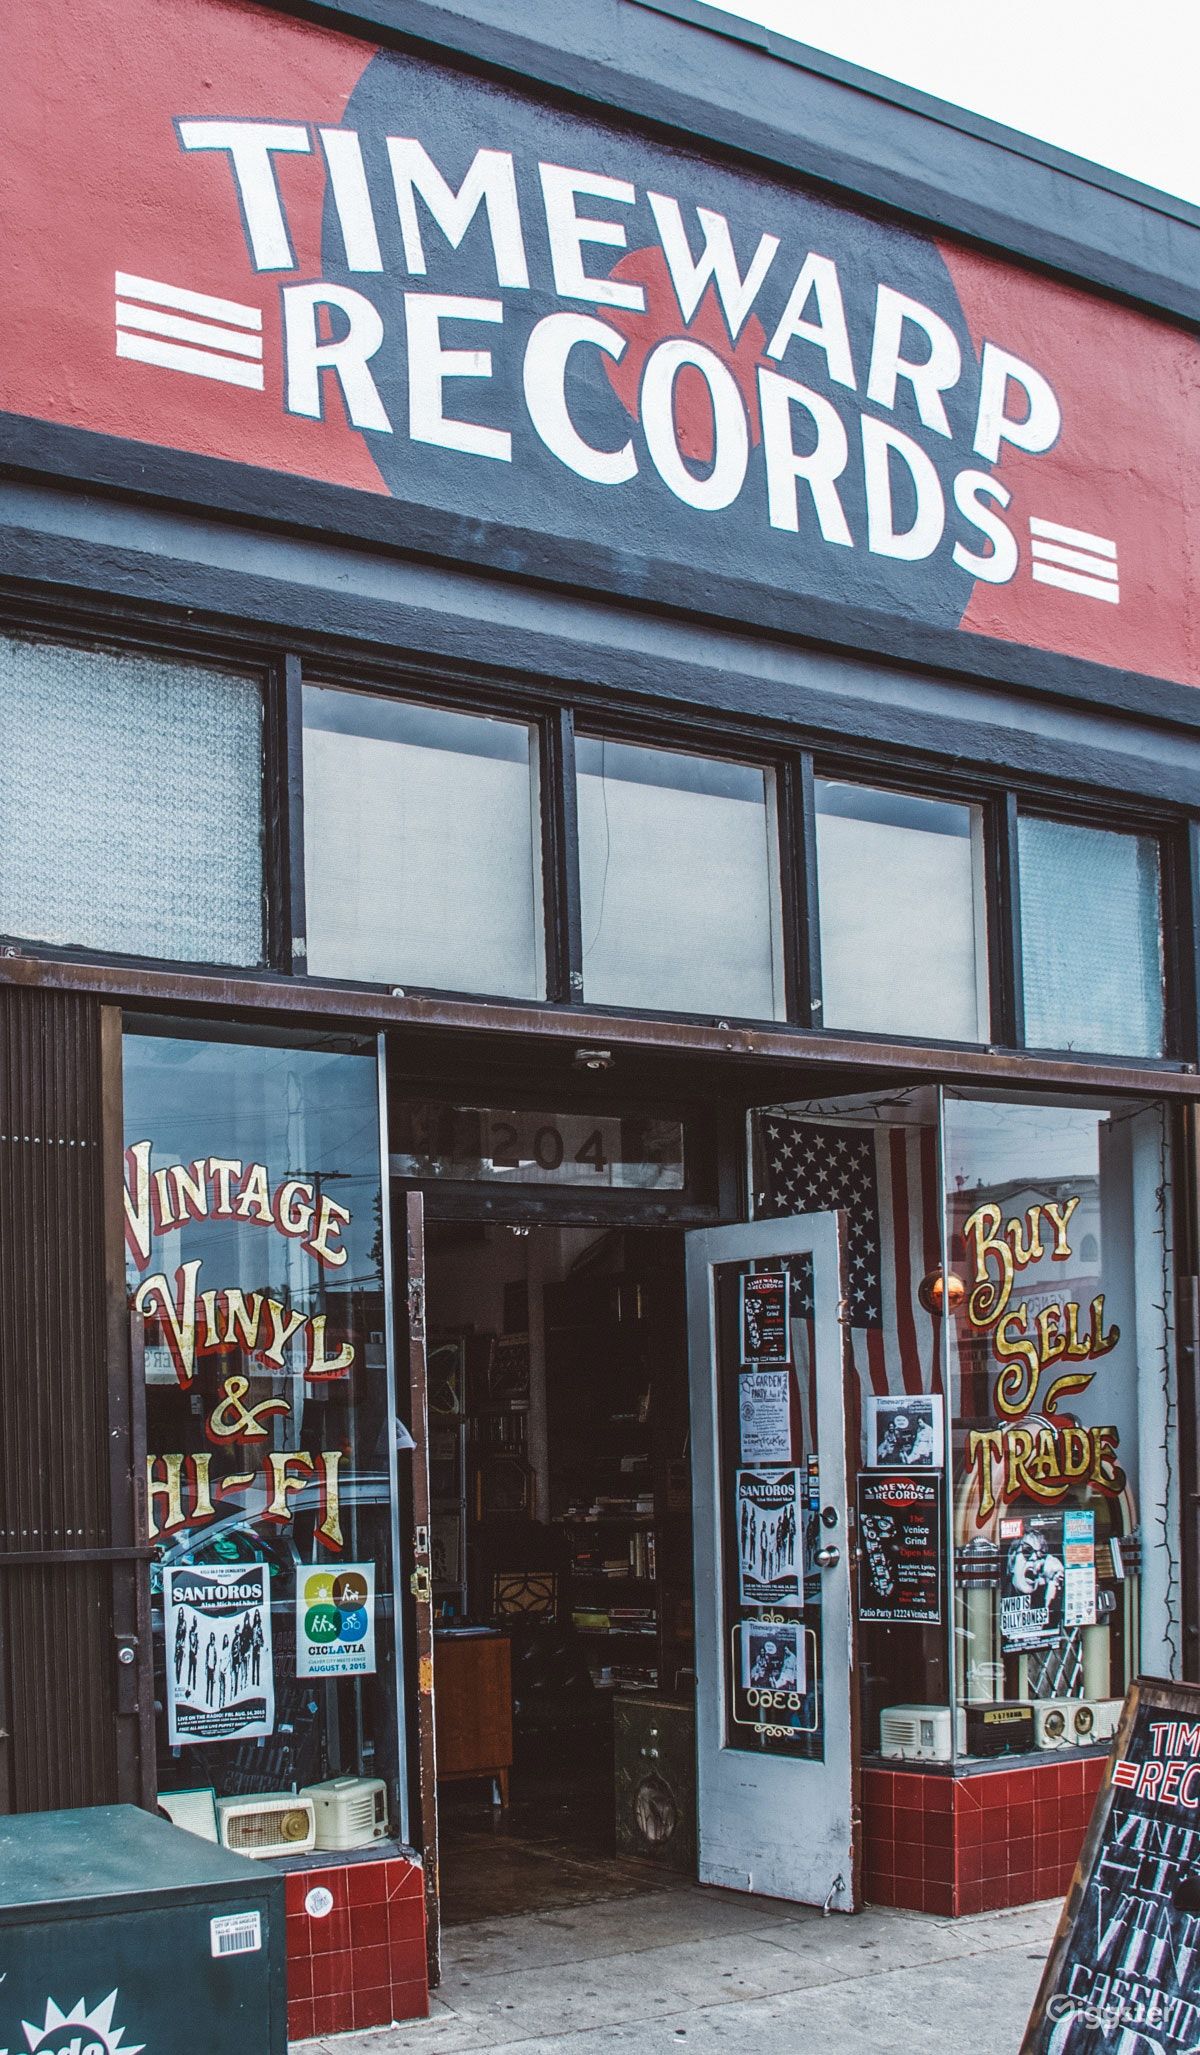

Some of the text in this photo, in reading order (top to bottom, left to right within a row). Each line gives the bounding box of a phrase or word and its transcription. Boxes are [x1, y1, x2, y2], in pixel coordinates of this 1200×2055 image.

[178, 121, 1061, 463] TIMEWARP
[282, 283, 1018, 584] RECORDS
[491, 1122, 607, 1173] 204
[124, 1139, 350, 1267] VINTAGE
[964, 1196, 1081, 1327] BUY
[135, 1259, 355, 1382] VINYL
[995, 1294, 1121, 1415] SELL
[211, 1375, 291, 1437] &
[740, 1484, 795, 1497] SANTOROS
[864, 1483, 935, 1495] TIMEWARP
[875, 1490, 924, 1500] RECORDS
[969, 1425, 1127, 1518] TRADE
[147, 1451, 343, 1548] HI-FI
[903, 1526, 930, 1534] Venice
[905, 1536, 927, 1545] Grind
[173, 1583, 262, 1602] SANTOROS
[860, 1608, 876, 1617] Patio
[876, 1608, 892, 1618] Party
[1002, 1595, 1030, 1613] WHO IS
[1002, 1612, 1020, 1630] BILLY
[308, 1643, 365, 1656] CICLAVIA
[308, 1664, 339, 1673] AUGUST
[349, 1662, 366, 1670] 2015
[1149, 1721, 1200, 1758] TIM
[1136, 1760, 1199, 1809] REC
[1112, 1809, 1200, 1866] VINT
[1091, 1883, 1200, 1990] VIN
